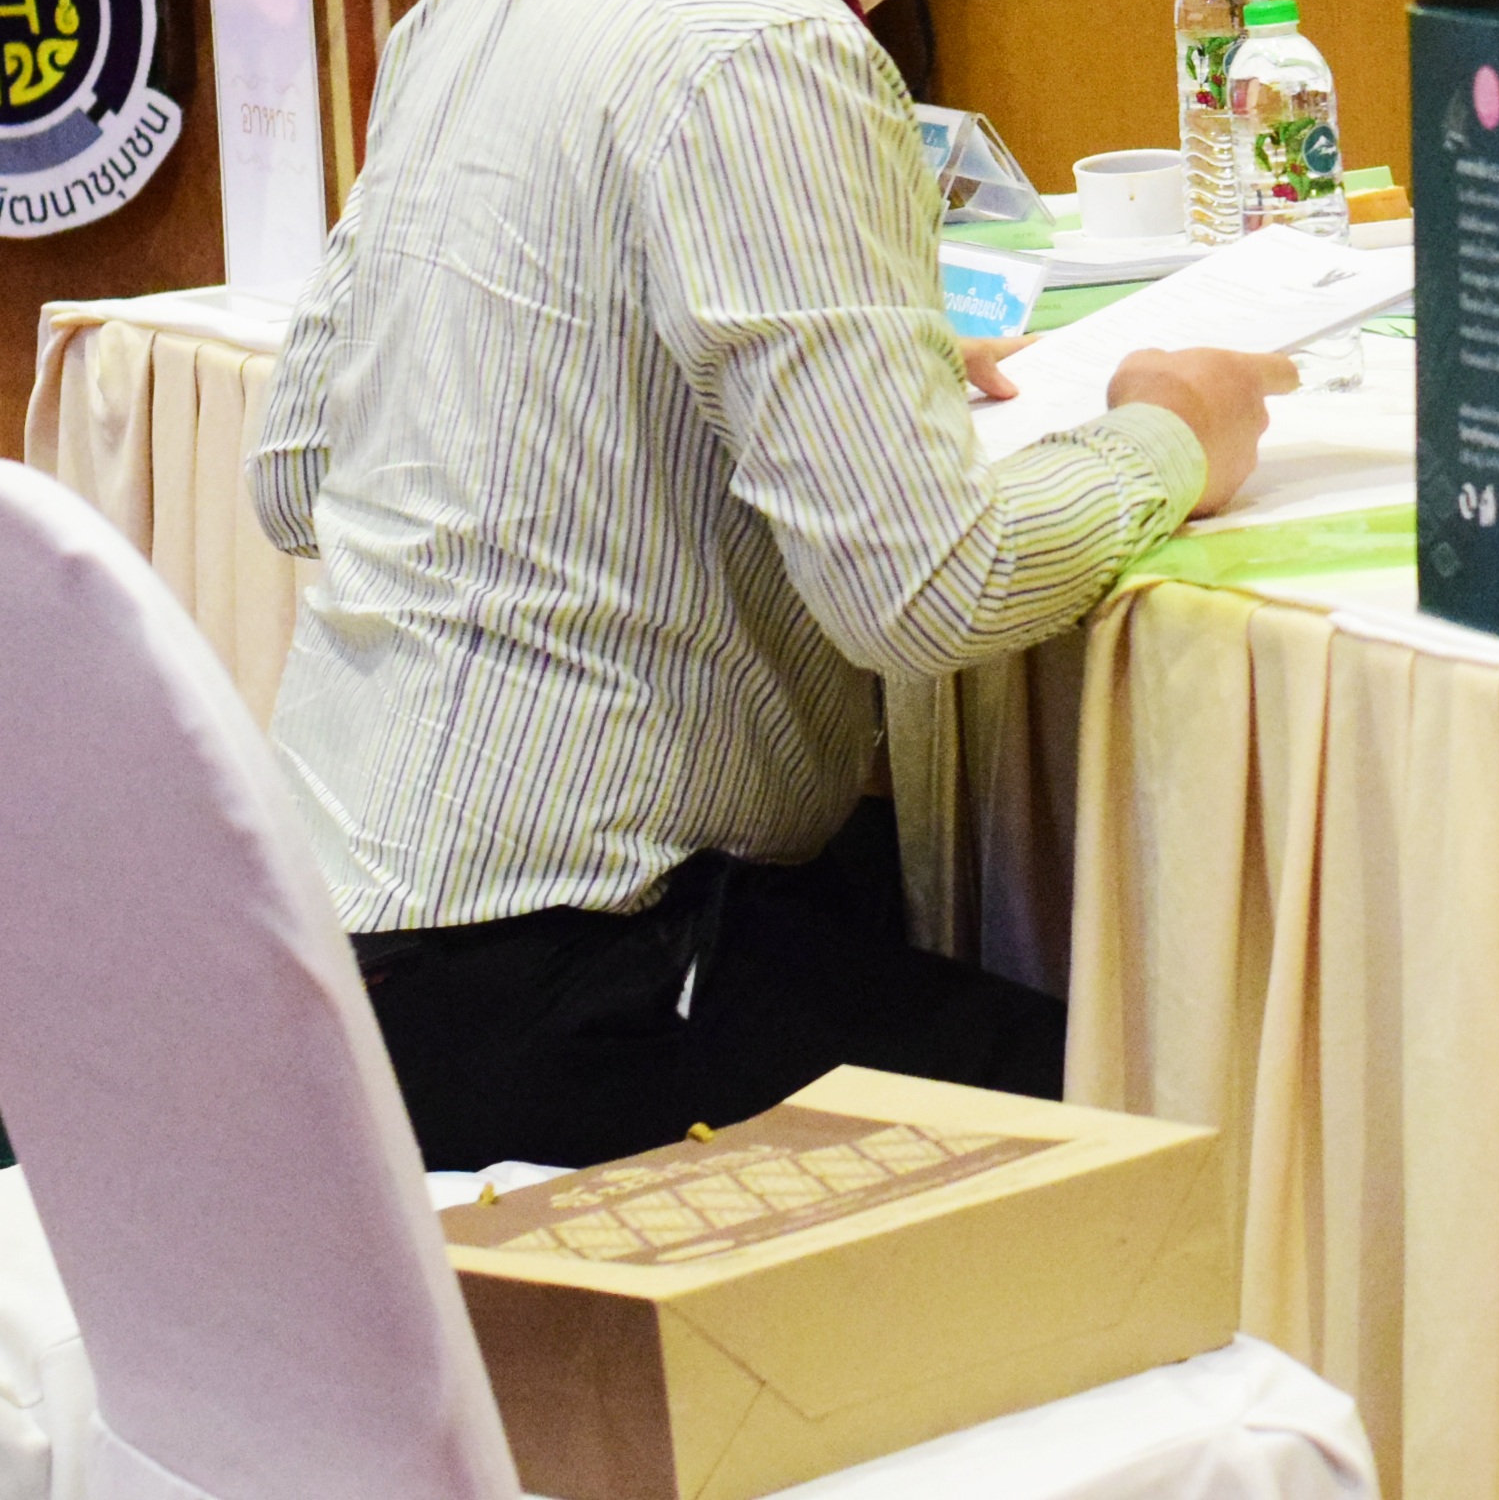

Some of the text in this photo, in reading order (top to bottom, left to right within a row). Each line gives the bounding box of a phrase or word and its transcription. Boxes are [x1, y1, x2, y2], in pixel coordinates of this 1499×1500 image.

[240, 102, 297, 142] อาหาร
[0, 103, 169, 225] ฒนาชุมชน
